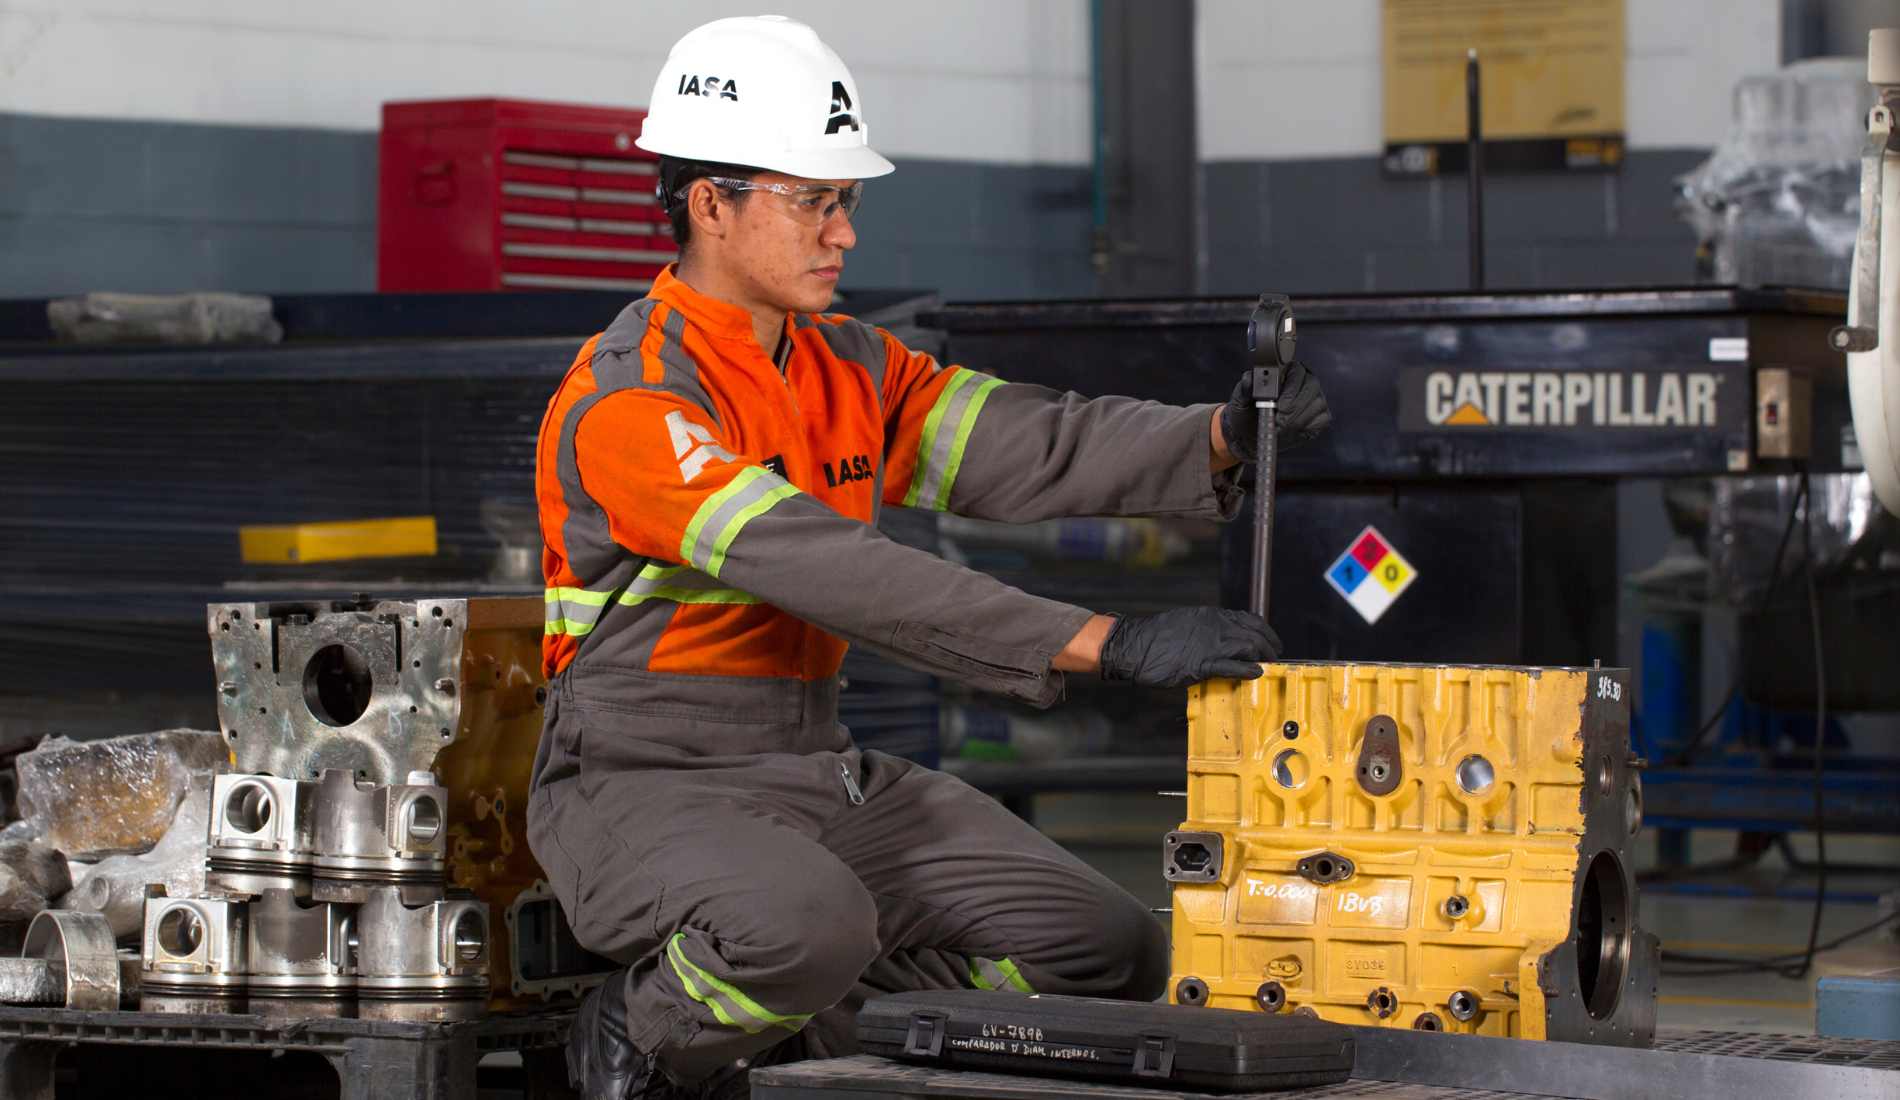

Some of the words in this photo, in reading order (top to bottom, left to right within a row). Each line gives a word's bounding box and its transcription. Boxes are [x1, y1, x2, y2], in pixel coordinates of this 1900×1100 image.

[678, 74, 739, 102] IASA
[824, 80, 860, 135] A
[1425, 372, 1719, 426] CATERPILLAR
[822, 454, 875, 489] IASA
[1384, 563, 1399, 583] 0
